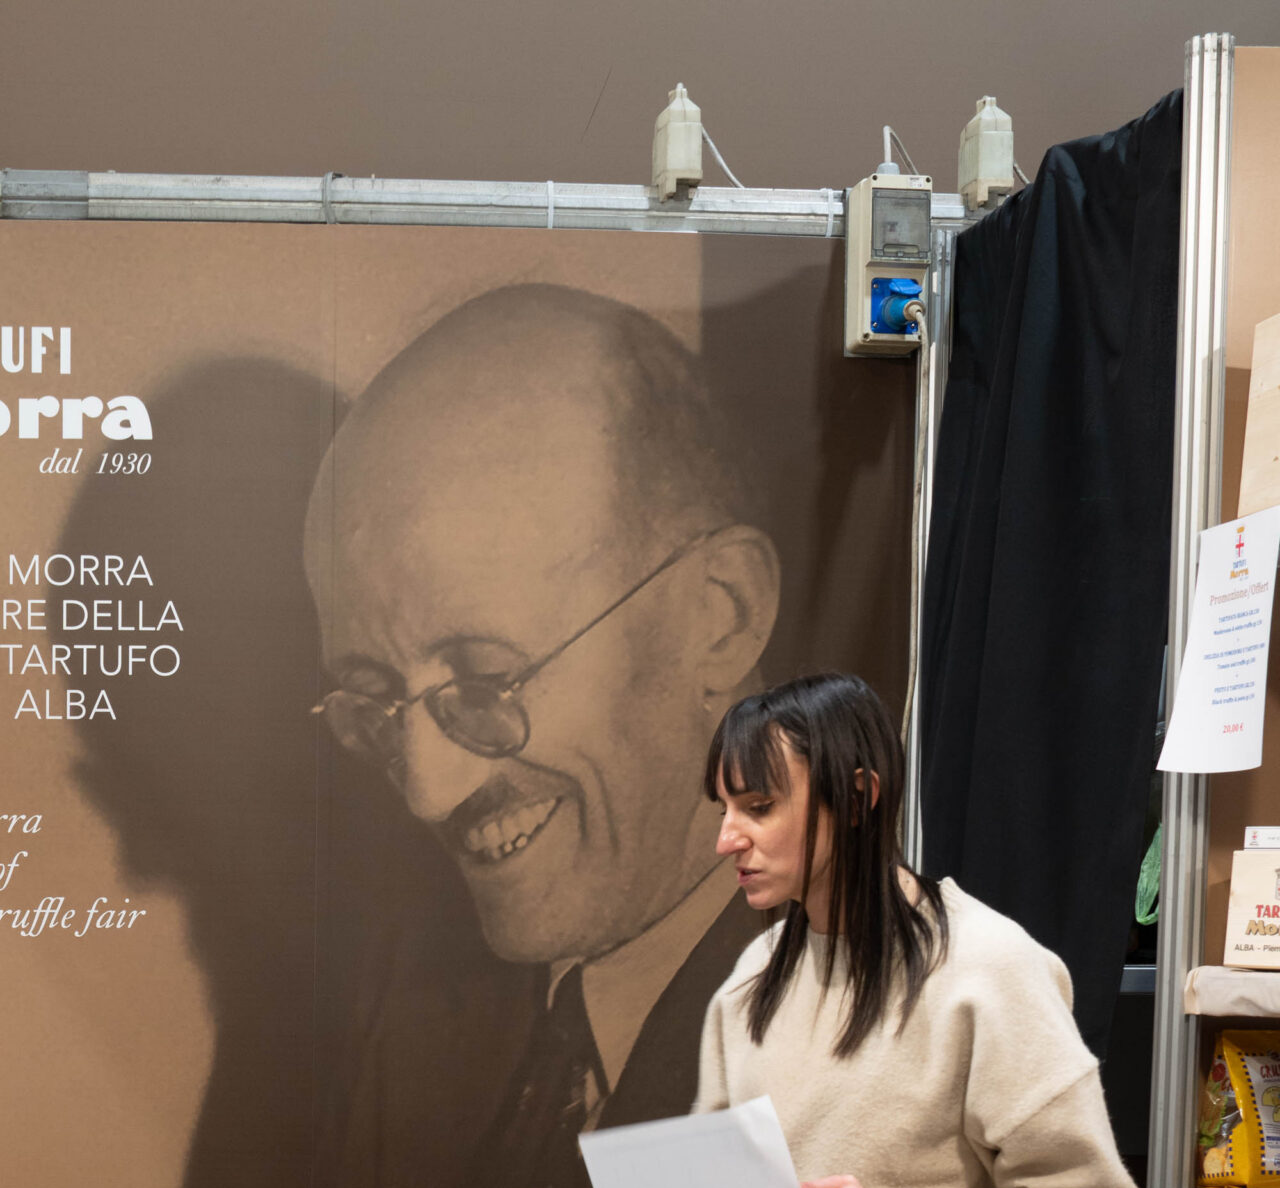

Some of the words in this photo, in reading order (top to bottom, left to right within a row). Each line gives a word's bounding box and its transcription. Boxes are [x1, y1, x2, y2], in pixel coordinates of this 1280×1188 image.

[39, 448, 83, 475] dal
[96, 452, 152, 475] 1930
[8, 554, 154, 586] MORRA
[62, 600, 184, 632] DELLA
[0, 644, 181, 677] TARTUFO
[14, 689, 117, 721] ALBA
[73, 897, 147, 937] fair
[1245, 919, 1280, 936] Mo
